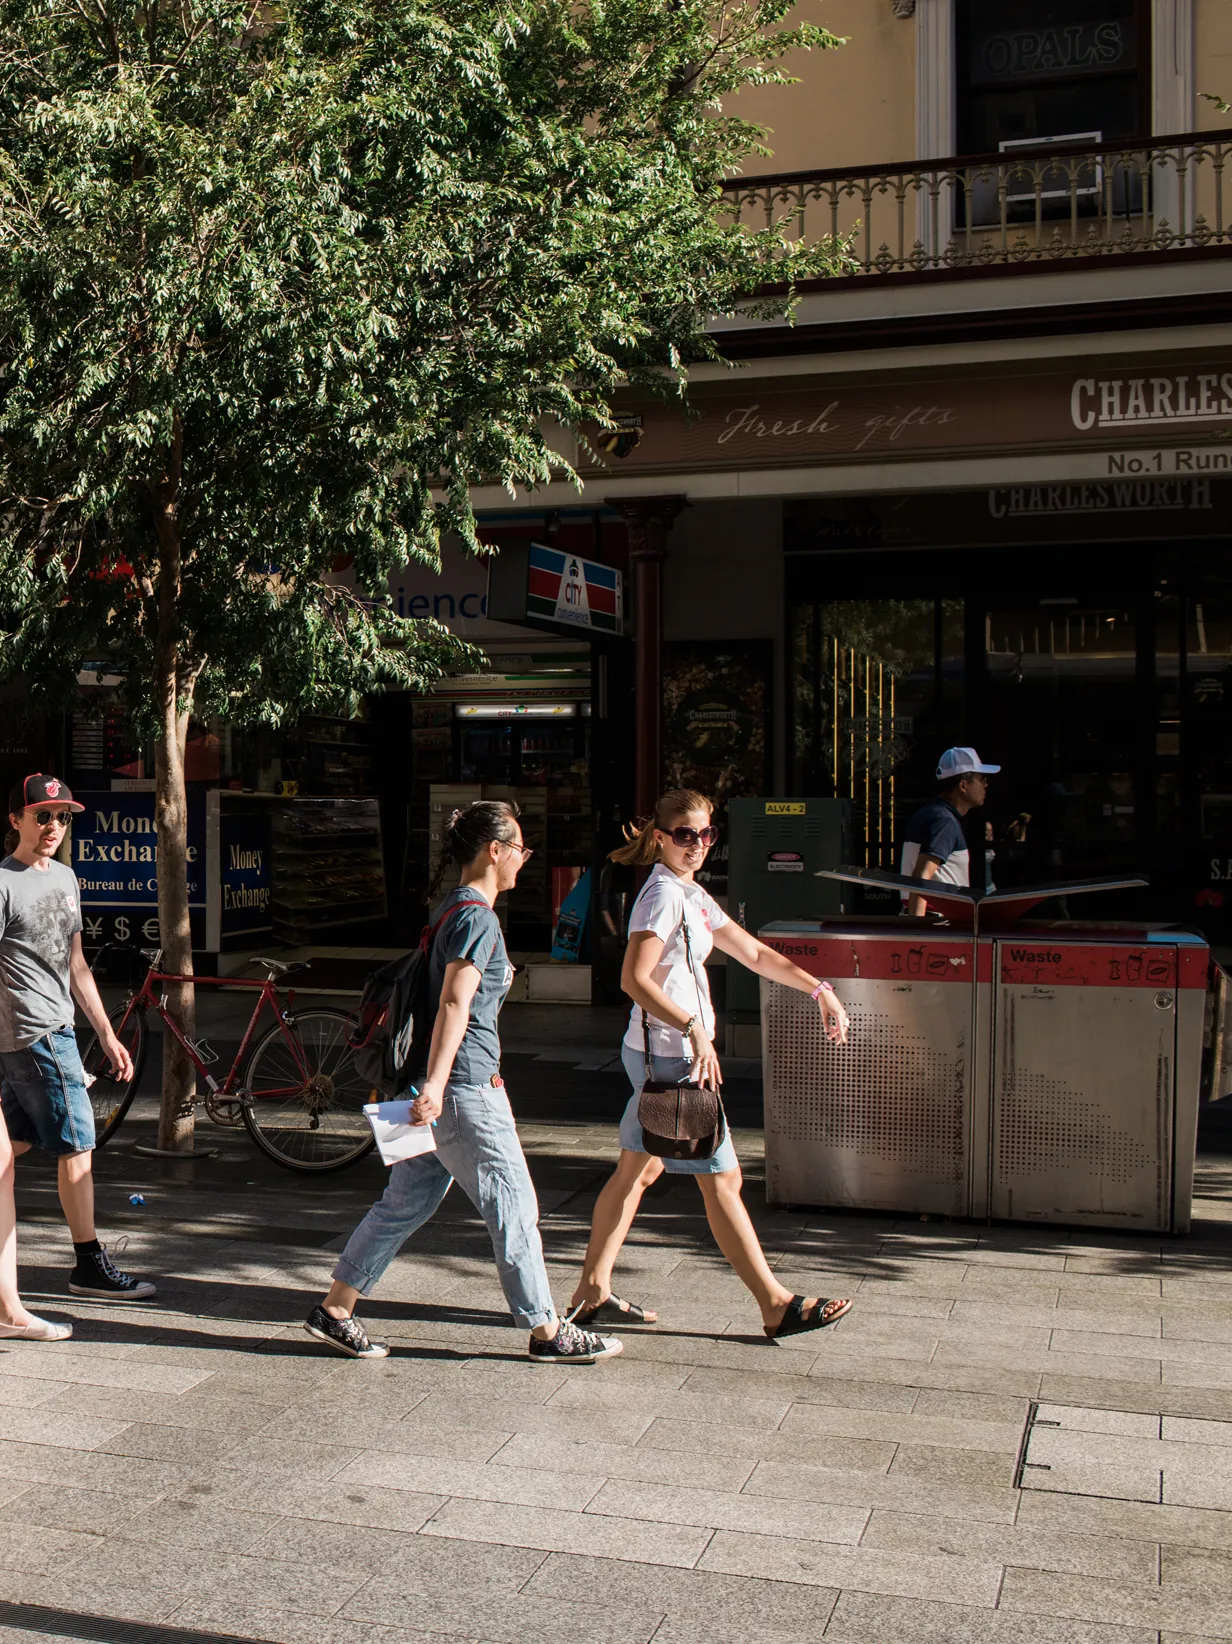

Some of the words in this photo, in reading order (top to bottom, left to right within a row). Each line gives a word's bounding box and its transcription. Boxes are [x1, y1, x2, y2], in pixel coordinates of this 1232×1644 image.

[984, 22, 1123, 76] OPALS
[718, 401, 840, 443] Fresh
[855, 405, 956, 451] gifts
[1108, 452, 1163, 474] No.1
[1175, 451, 1232, 470] Run
[988, 478, 1213, 518] CHARLESWORTH
[767, 805, 791, 813] ALV4
[94, 811, 158, 834] Mon
[77, 839, 198, 863] Exchae
[229, 844, 264, 875] Money
[79, 878, 124, 891] Bureau
[128, 878, 143, 891] de
[223, 883, 271, 912] Exchange
[770, 942, 818, 956] Waste
[1010, 949, 1062, 963] Waste
